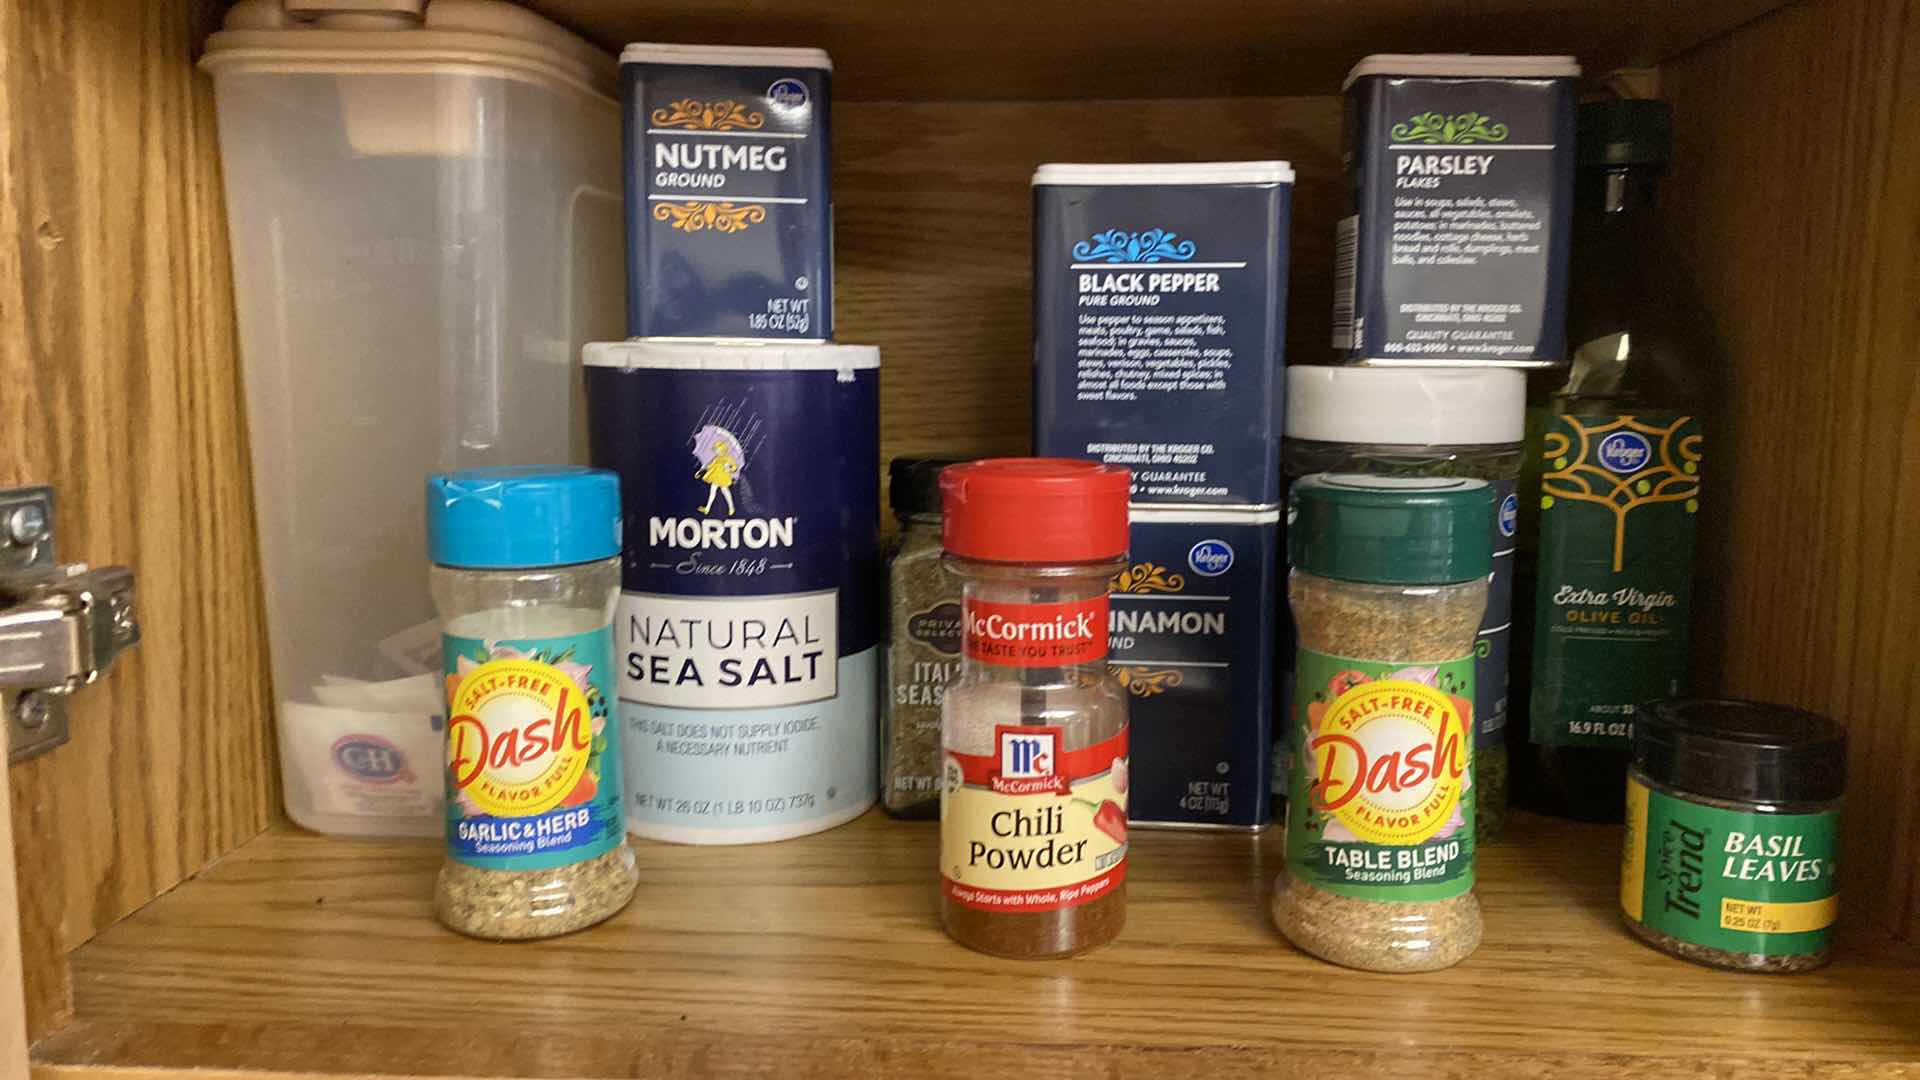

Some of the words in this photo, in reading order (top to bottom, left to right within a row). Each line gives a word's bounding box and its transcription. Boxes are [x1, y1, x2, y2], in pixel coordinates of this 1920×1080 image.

[655, 143, 787, 171] NUTMEG
[1396, 156, 1494, 175] PARSLEY
[655, 172, 725, 188] GROUND
[1396, 177, 1440, 188] FLAKES
[1394, 197, 1413, 207] Use
[1078, 273, 1144, 292] BLACK
[1149, 273, 1220, 292] PEPPER
[768, 298, 789, 313] NET
[790, 298, 808, 313] WT
[1078, 295, 1107, 306] PURE
[1110, 295, 1160, 306] GROUND
[769, 314, 785, 329] OZ
[1078, 314, 1096, 326] Use
[1097, 314, 1130, 326] pepper
[1131, 314, 1142, 326] to
[1143, 314, 1175, 326] season
[1078, 326, 1108, 336] meats,
[1406, 331, 1449, 340] QUALITY
[1451, 331, 1515, 340] GUARANTEE
[1118, 337, 1127, 348] in
[1120, 380, 1146, 390] foods
[1147, 380, 1178, 392] except
[1179, 380, 1205, 390] those
[1206, 380, 1227, 390] with
[1077, 391, 1104, 401] sweet
[1139, 443, 1150, 454] BY
[1151, 443, 1166, 454] THE
[1605, 438, 1645, 466] Kroger
[1141, 472, 1206, 482] GUARANTEE
[1148, 484, 1228, 497] www.kroger.com
[650, 517, 794, 550] MORTON
[676, 552, 727, 575] Since
[728, 558, 768, 576] 1848
[1195, 546, 1228, 571] Kroger
[1553, 585, 1609, 605] Extra
[1611, 587, 1676, 612] Virgin
[1109, 610, 1225, 634] NAMON
[1567, 610, 1621, 624] OLIVE
[1628, 612, 1659, 624] OIL
[630, 615, 821, 650] NATURAL
[1018, 644, 1046, 657] YOU
[627, 652, 703, 687] SEA
[719, 650, 822, 687] SALT
[464, 674, 552, 711] SALT-FREE
[1339, 696, 1435, 731] SALT-FREE
[650, 719, 674, 736] SALT
[676, 723, 707, 738] DOES
[710, 725, 733, 739] NOT
[738, 723, 780, 738] SUPPLY
[1568, 720, 1592, 734] 16.9
[1592, 722, 1607, 735] FL
[1608, 723, 1626, 736] OZ
[448, 687, 590, 789] Dash
[666, 741, 729, 756] NECESSARY
[1310, 711, 1464, 811] Dash
[481, 781, 540, 802] FLAVOR
[545, 755, 573, 788] FULL
[992, 776, 1063, 793] McCormick
[635, 793, 654, 809] NET
[657, 798, 673, 811] WT
[676, 800, 690, 814] 26
[694, 800, 711, 815] OZ
[728, 801, 744, 814] LB
[749, 800, 763, 813] 10
[1356, 805, 1420, 829] FLAVOR
[1425, 784, 1450, 817] FULL
[991, 806, 1063, 838] Chili
[475, 839, 534, 854] Seasoning
[537, 832, 572, 849] Blend
[1724, 832, 1805, 857] BASIL
[969, 839, 1088, 870] Powder
[1325, 847, 1392, 869] TABLE
[1397, 841, 1459, 869] BLEND
[1345, 868, 1410, 884] Seasoning
[1414, 866, 1446, 881] Blend
[1664, 819, 1705, 920] Trend
[1722, 856, 1823, 882] LEAVES
[976, 891, 1001, 905] Starts
[1002, 893, 1024, 906] with
[1059, 888, 1079, 902] Ripe
[1080, 877, 1110, 897] Peppers
[1725, 903, 1745, 914] NET
[1747, 905, 1762, 916] WT
[1747, 917, 1761, 929] OZ
